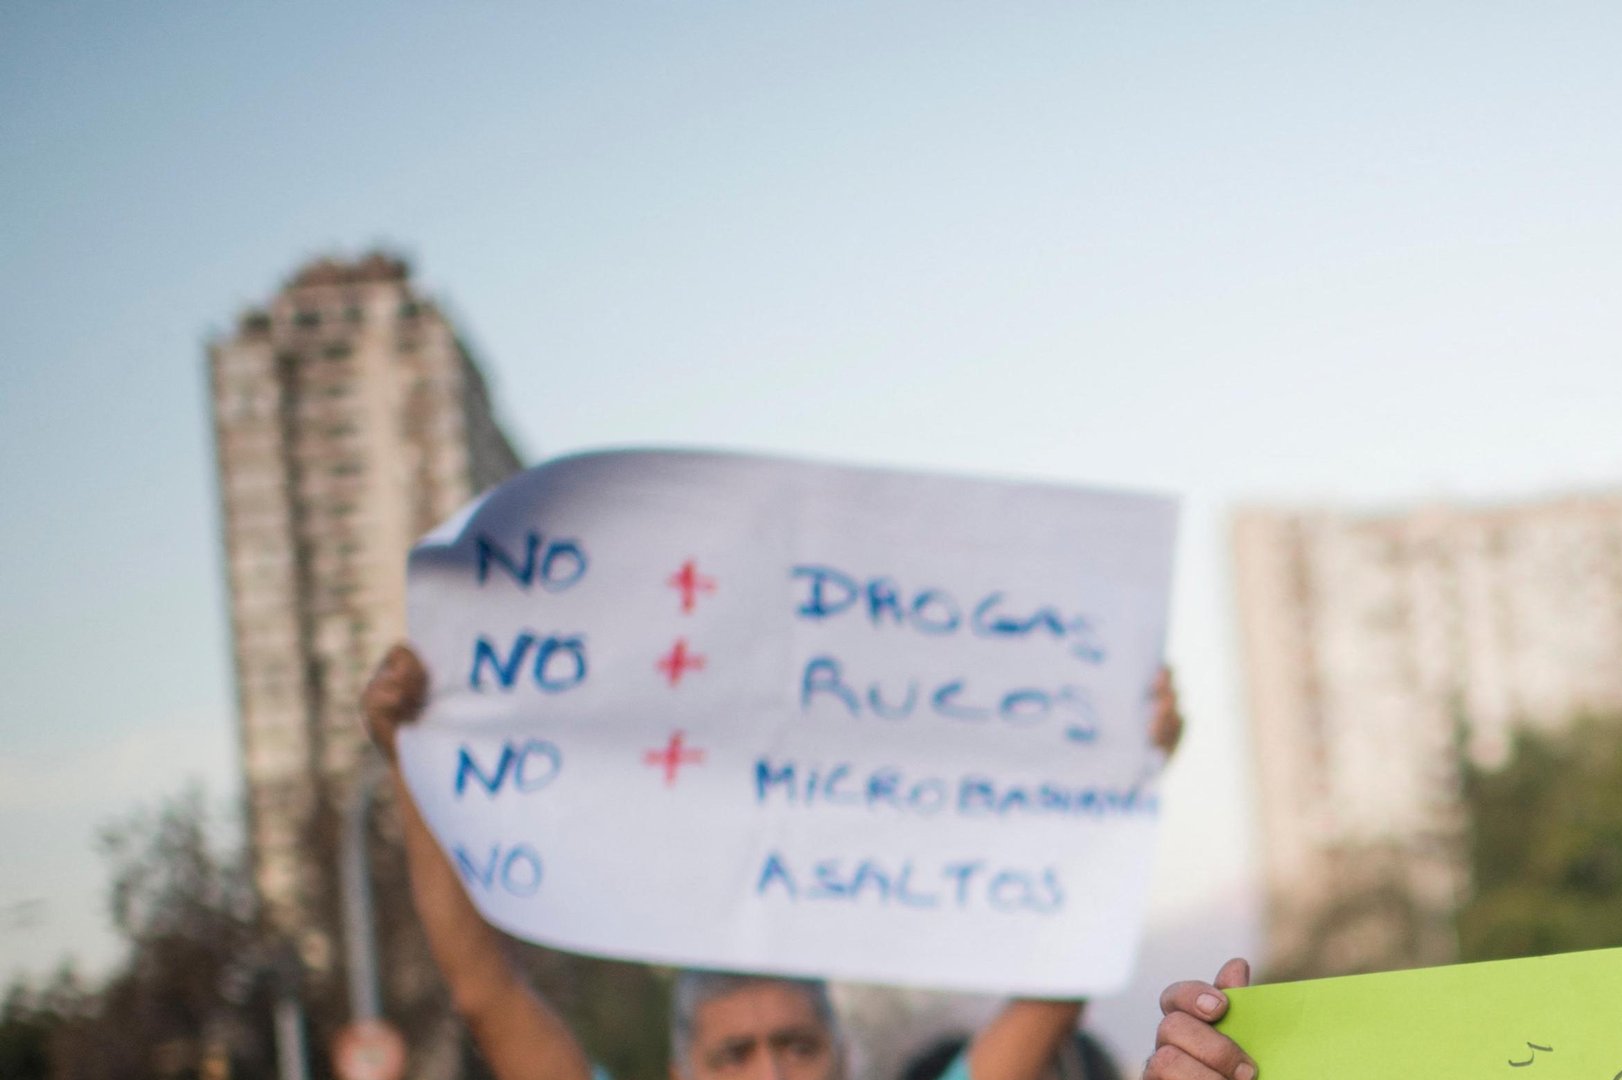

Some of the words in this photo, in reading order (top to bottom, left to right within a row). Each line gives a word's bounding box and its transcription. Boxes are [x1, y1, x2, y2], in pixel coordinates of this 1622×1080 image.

[473, 529, 590, 592] NO
[468, 630, 589, 694] NO
[799, 656, 1103, 746] RUCOS
[453, 738, 562, 799] NO
[451, 842, 544, 898] NO
[756, 850, 1066, 913] ASALTOS
